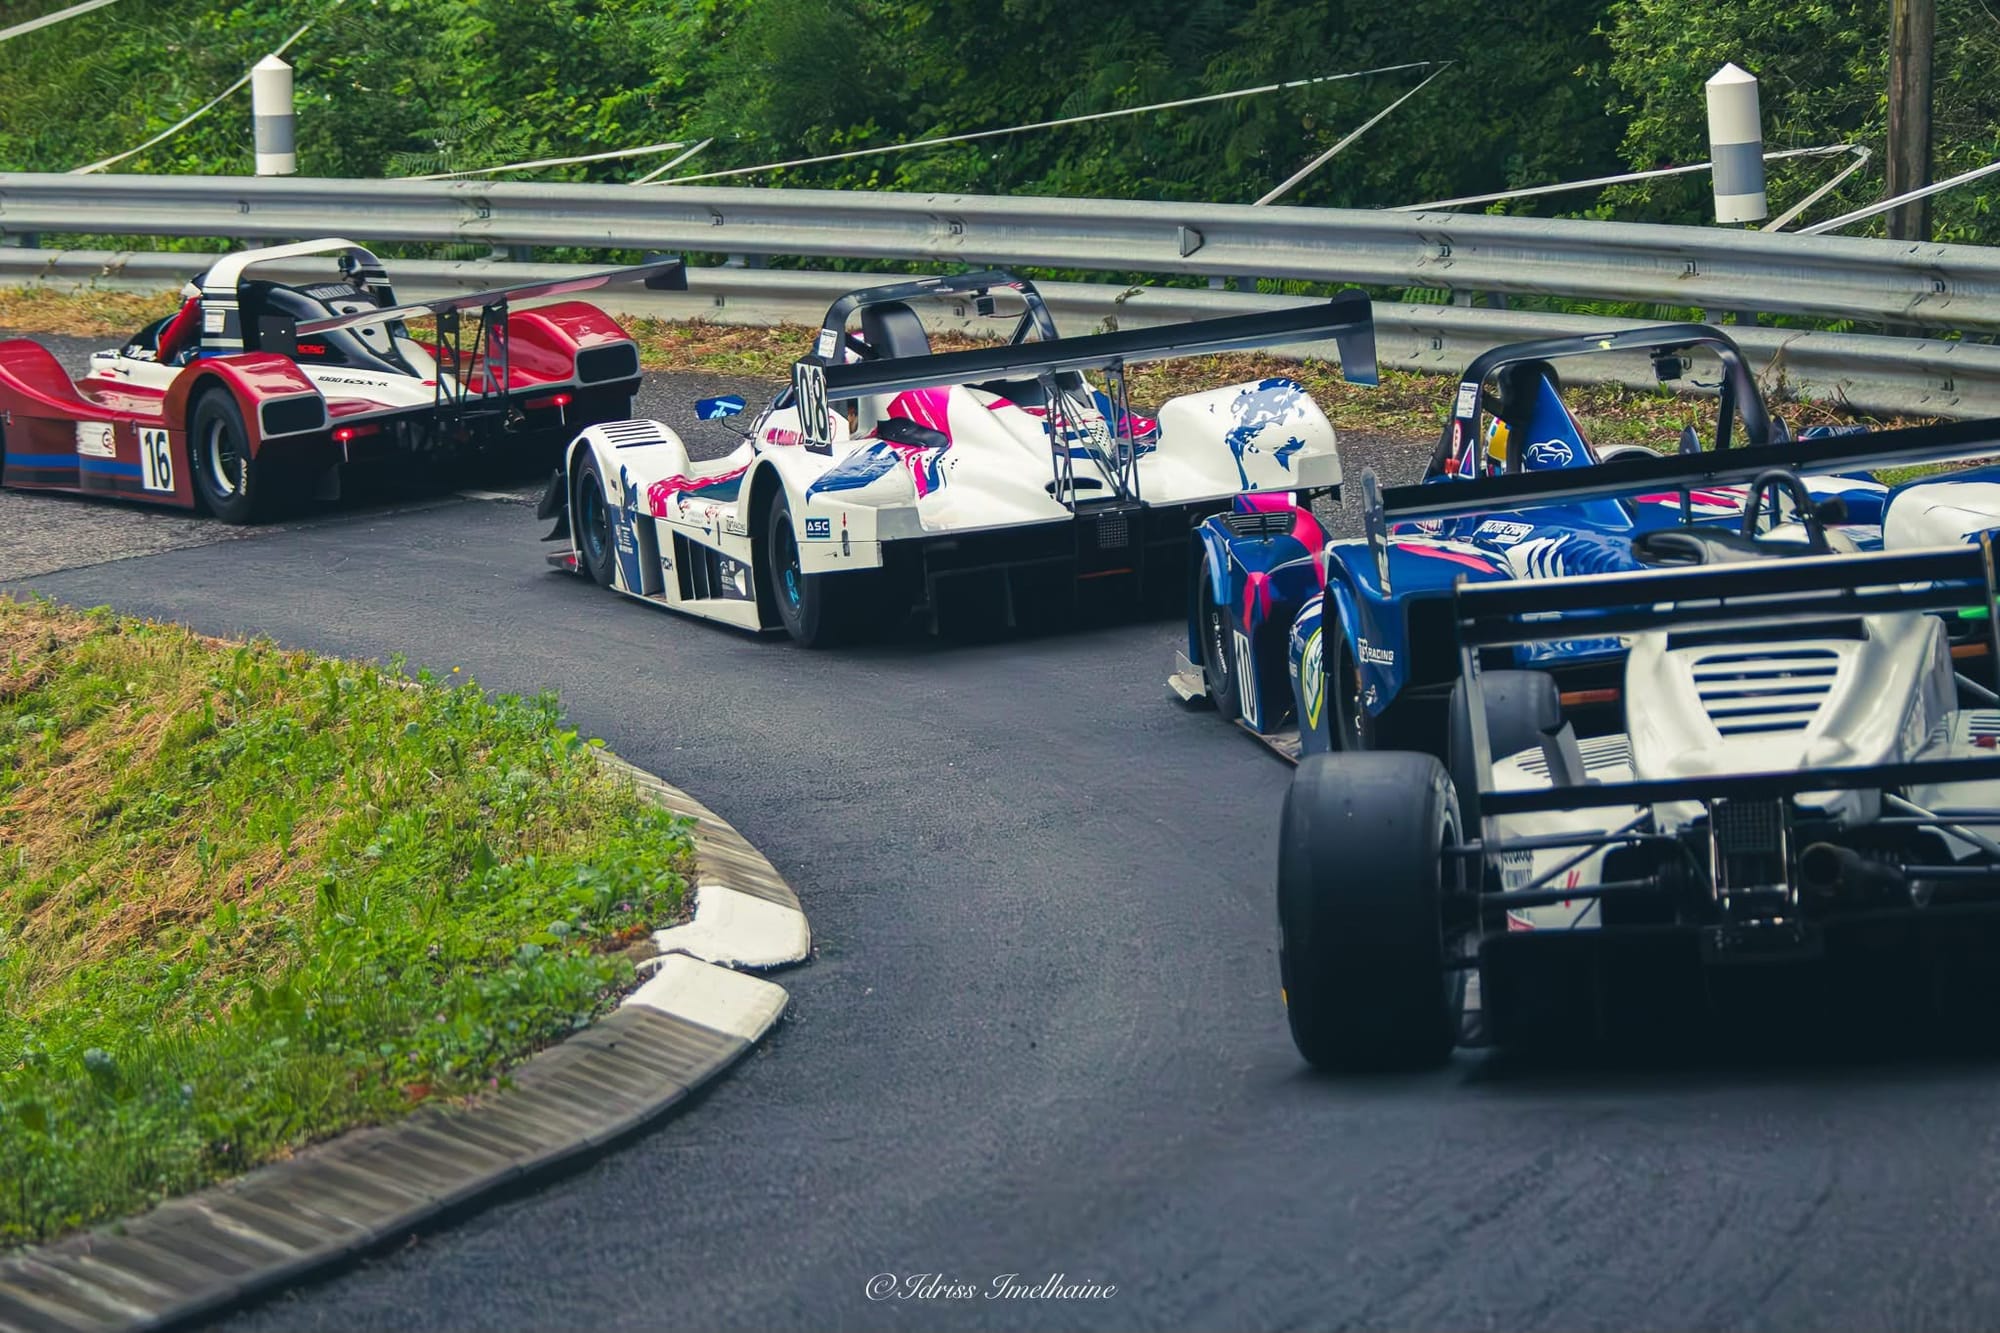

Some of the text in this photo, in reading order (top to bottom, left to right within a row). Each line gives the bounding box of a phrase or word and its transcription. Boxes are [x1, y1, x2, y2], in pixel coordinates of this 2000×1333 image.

[317, 375, 342, 384] 1000
[145, 431, 172, 489] 16
[807, 521, 829, 531] ASC
[1367, 647, 1395, 662] RACING
